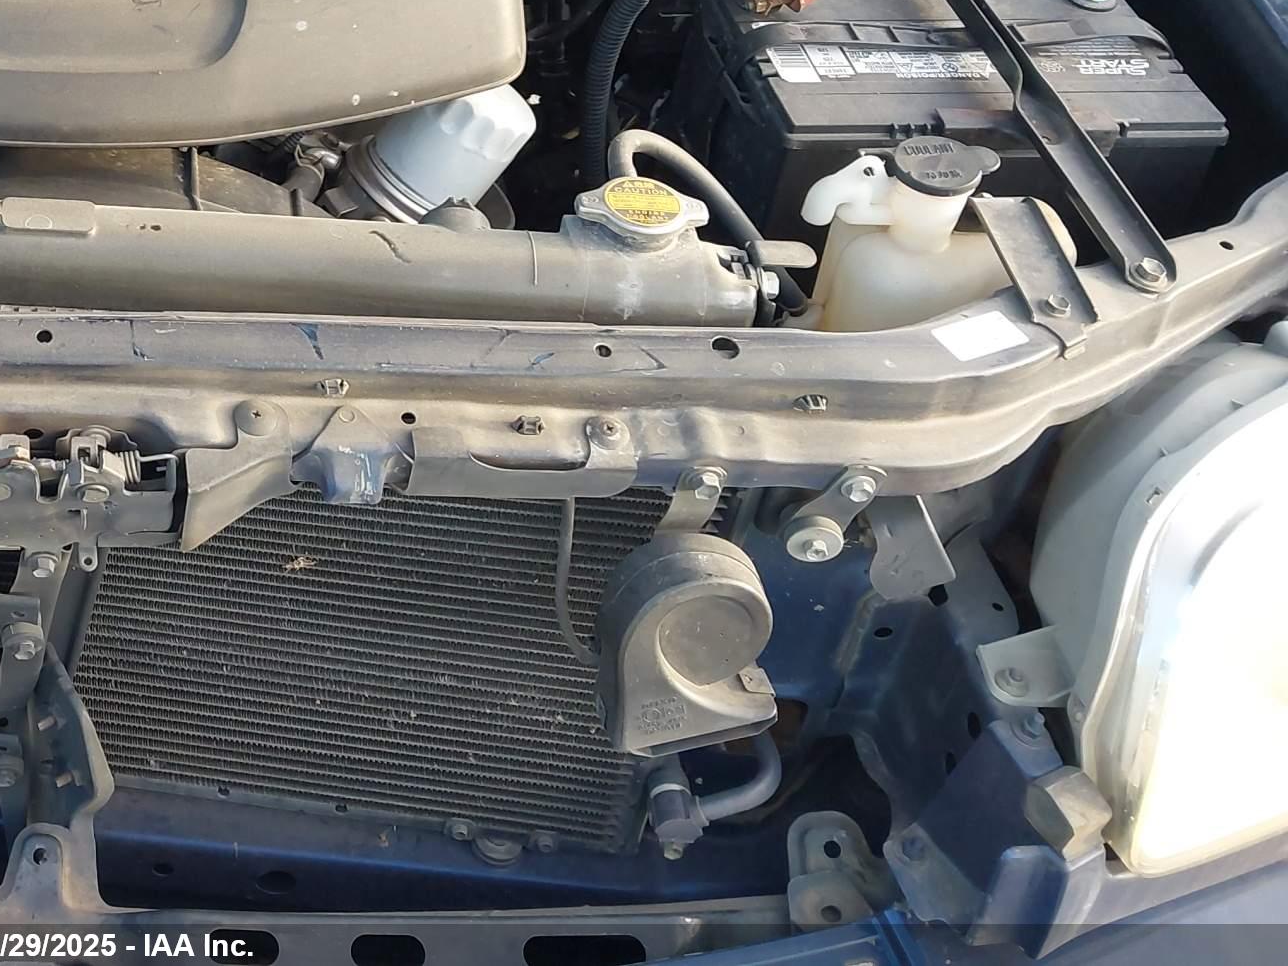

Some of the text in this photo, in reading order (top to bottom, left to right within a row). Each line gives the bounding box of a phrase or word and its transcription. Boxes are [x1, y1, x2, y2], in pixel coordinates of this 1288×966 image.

[1076, 59, 1149, 68] START
[1079, 67, 1148, 76] SUPER
[903, 142, 954, 156] COOLANT
[614, 186, 668, 196] CAUTION
